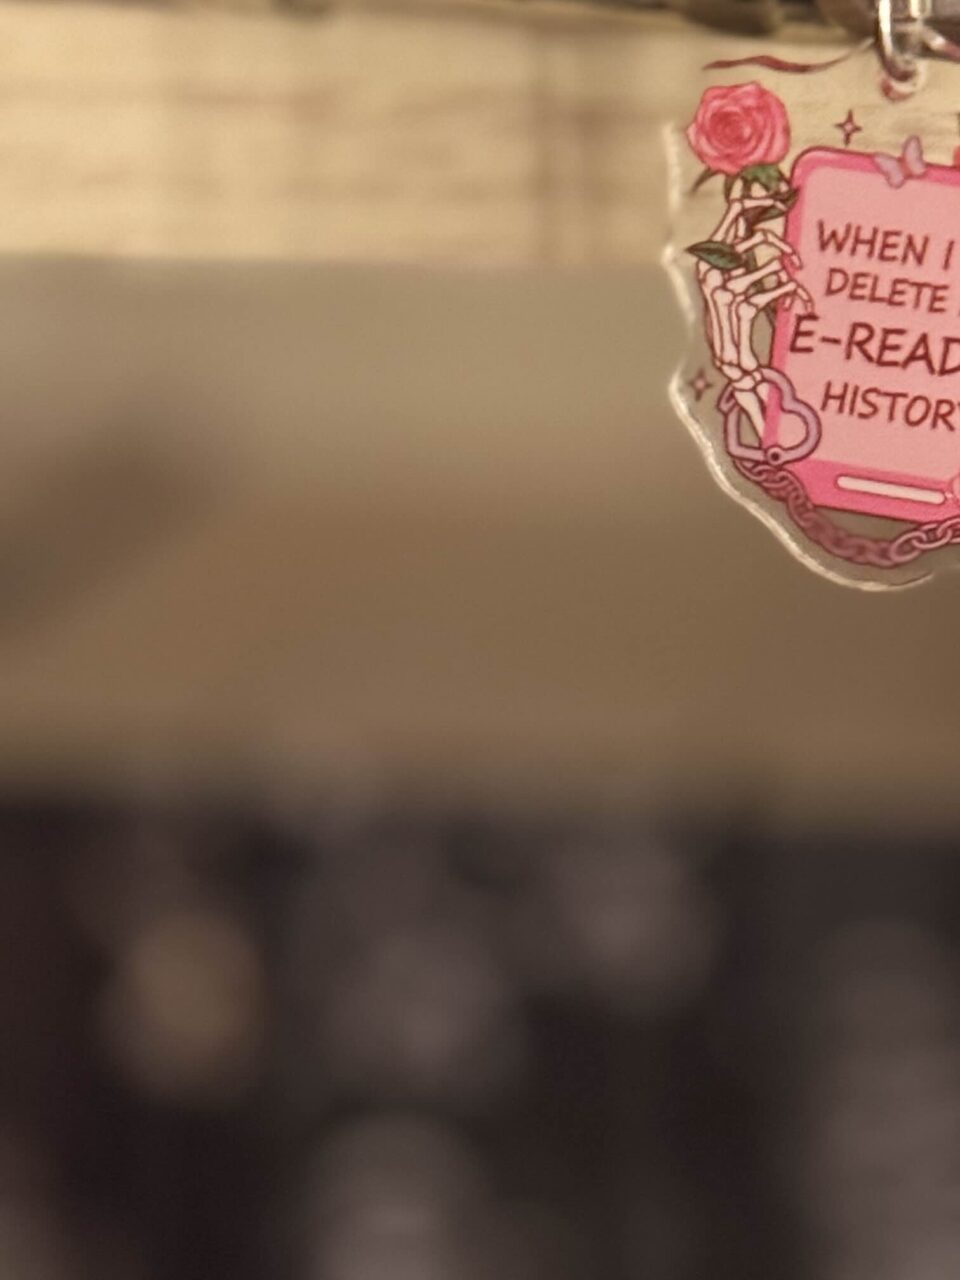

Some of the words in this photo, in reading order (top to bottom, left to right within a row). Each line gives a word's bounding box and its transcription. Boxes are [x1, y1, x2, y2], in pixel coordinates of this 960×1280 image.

[817, 219, 930, 267] WHEN
[943, 239, 955, 271] I
[824, 267, 949, 313] DELETE
